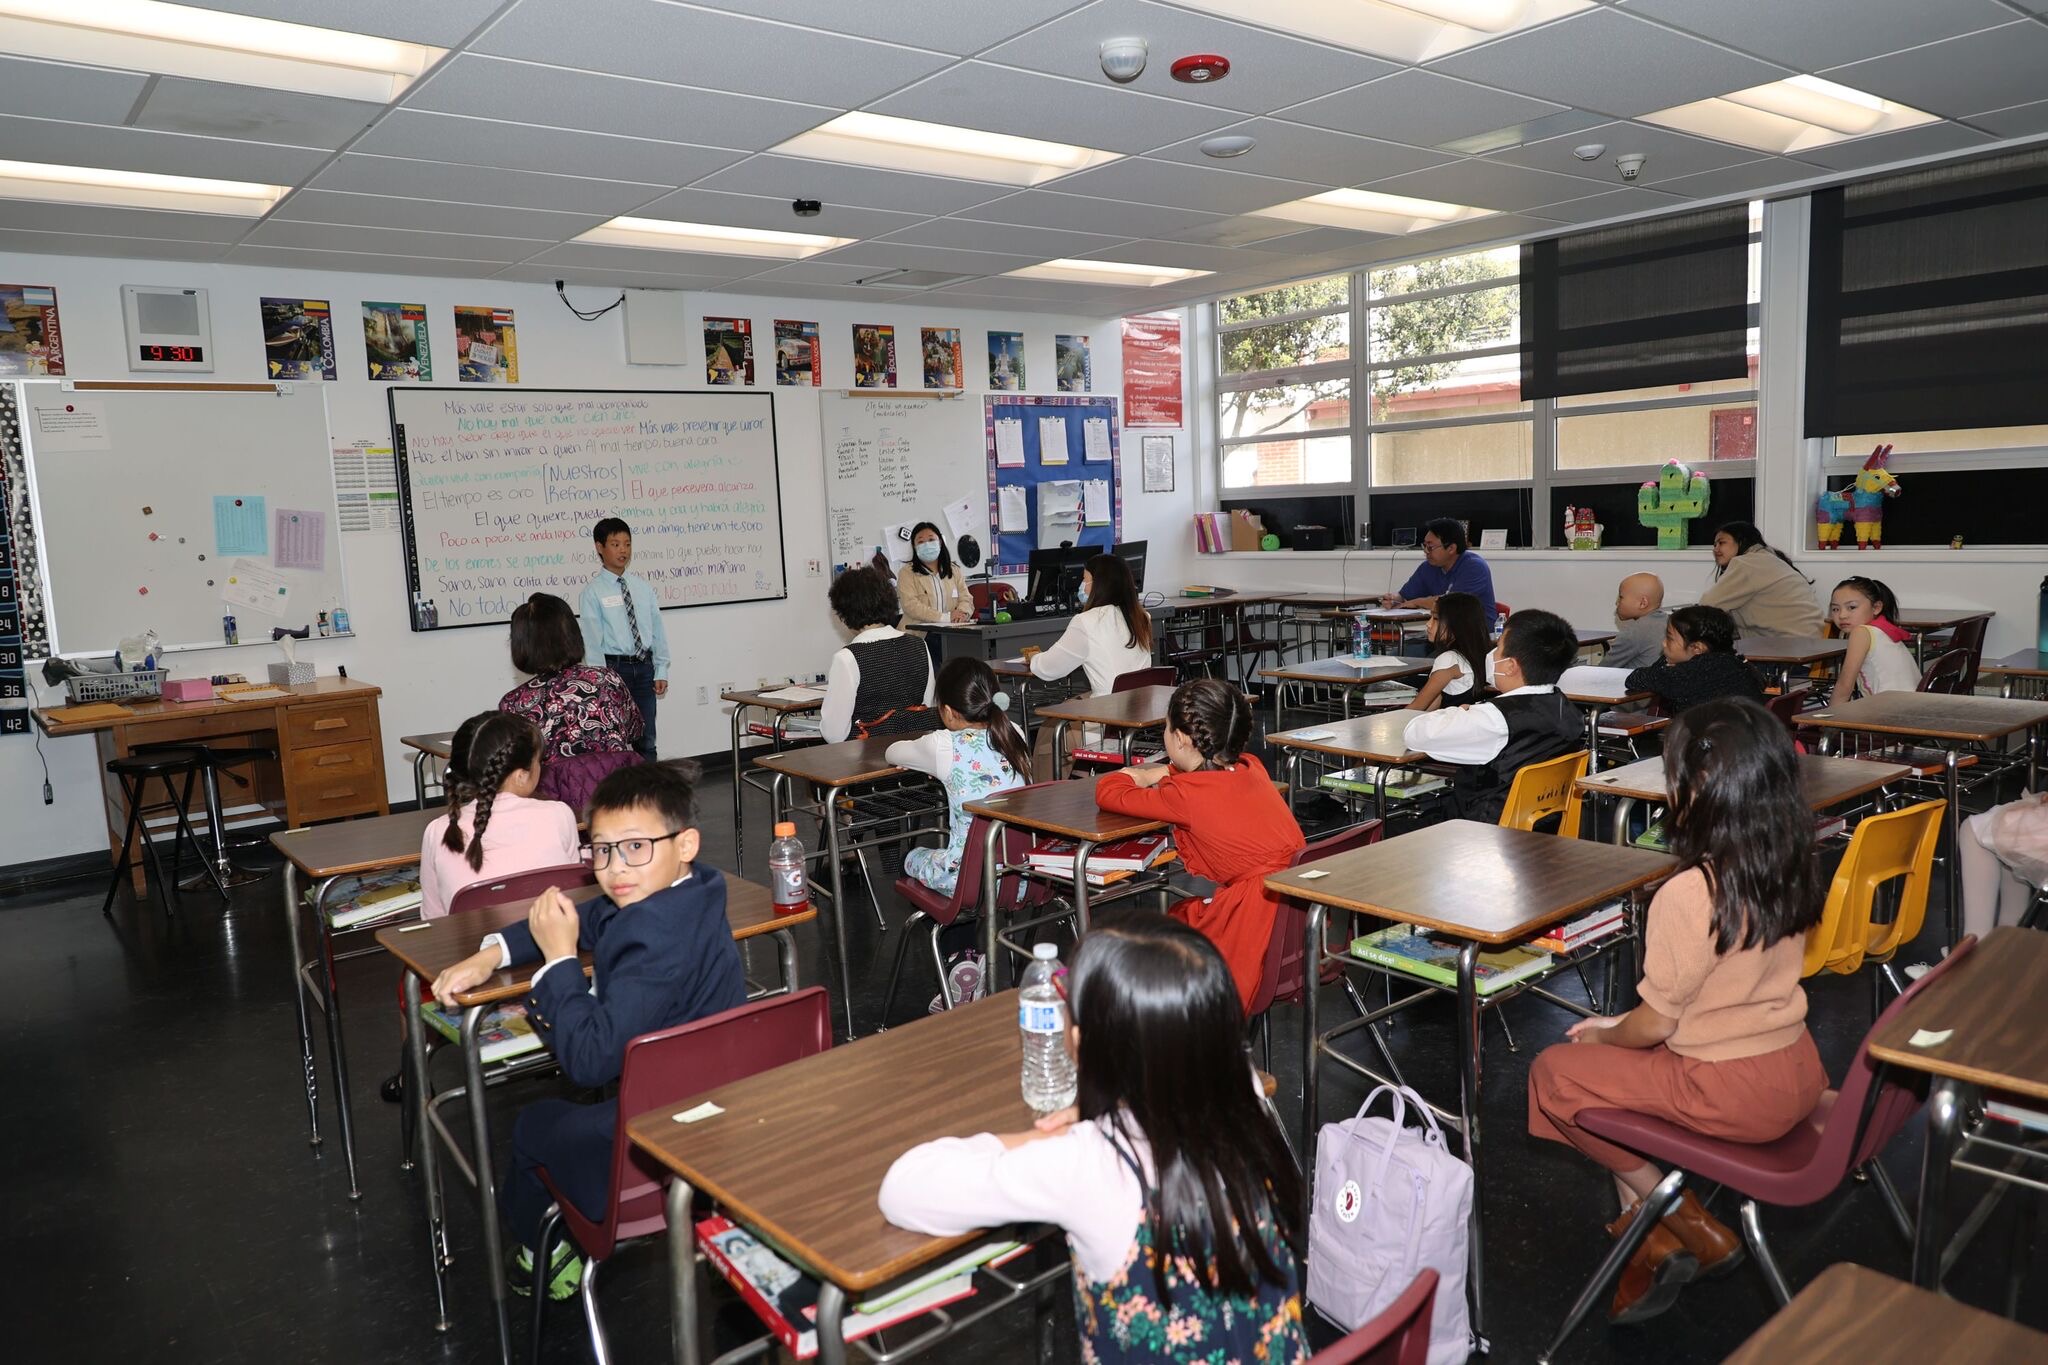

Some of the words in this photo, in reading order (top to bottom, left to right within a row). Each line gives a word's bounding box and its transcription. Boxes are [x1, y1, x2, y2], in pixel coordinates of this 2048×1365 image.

[45, 307, 64, 365] ARGENTINA
[319, 317, 335, 369] COLOMBIA
[414, 321, 431, 375] VENEZUELA
[742, 335, 753, 360] PERÚ
[812, 339, 820, 373] SALVADOR
[887, 341, 896, 373] BOLIVIA
[954, 344, 963, 385] GUATEMALA
[470, 402, 494, 414] vale
[500, 402, 526, 414] estar
[533, 400, 553, 414] solo
[555, 401, 574, 412] que
[578, 399, 594, 411] mal
[458, 415, 474, 431] No
[476, 413, 498, 429] hay
[501, 416, 518, 427] mal
[525, 413, 544, 426] que
[660, 422, 680, 434] vale
[682, 419, 719, 436] prevenir
[720, 419, 738, 436] que
[412, 436, 430, 449] No
[432, 434, 454, 447] hay
[586, 438, 597, 455] Al
[600, 439, 620, 453] mal
[697, 435, 718, 447] cara
[411, 449, 434, 464] Haz
[484, 447, 500, 459] sin
[539, 445, 547, 455] a
[549, 463, 618, 482] Nuestros
[655, 461, 679, 474] con
[422, 490, 439, 511] El
[440, 488, 482, 510] tiempo
[487, 488, 504, 501] es
[508, 487, 535, 500] oro
[549, 485, 619, 505] Refranes
[631, 479, 644, 500] El
[647, 485, 669, 502] que
[474, 511, 489, 527] El
[494, 512, 521, 532] que
[573, 507, 606, 525] puede
[658, 506, 667, 522] y
[642, 522, 655, 534] un
[440, 531, 467, 549] Poco
[471, 536, 480, 545] a
[515, 531, 526, 543] se
[424, 558, 441, 573] De
[445, 556, 461, 570] los
[505, 555, 520, 569] se
[523, 553, 566, 574] aprende
[438, 574, 477, 594] Sana,
[479, 575, 507, 589] sana
[545, 573, 560, 586] de
[664, 585, 680, 600] No
[448, 598, 472, 618] No
[0, 653, 16, 665] 30
[4, 685, 20, 697] 36
[6, 719, 22, 731] 42
